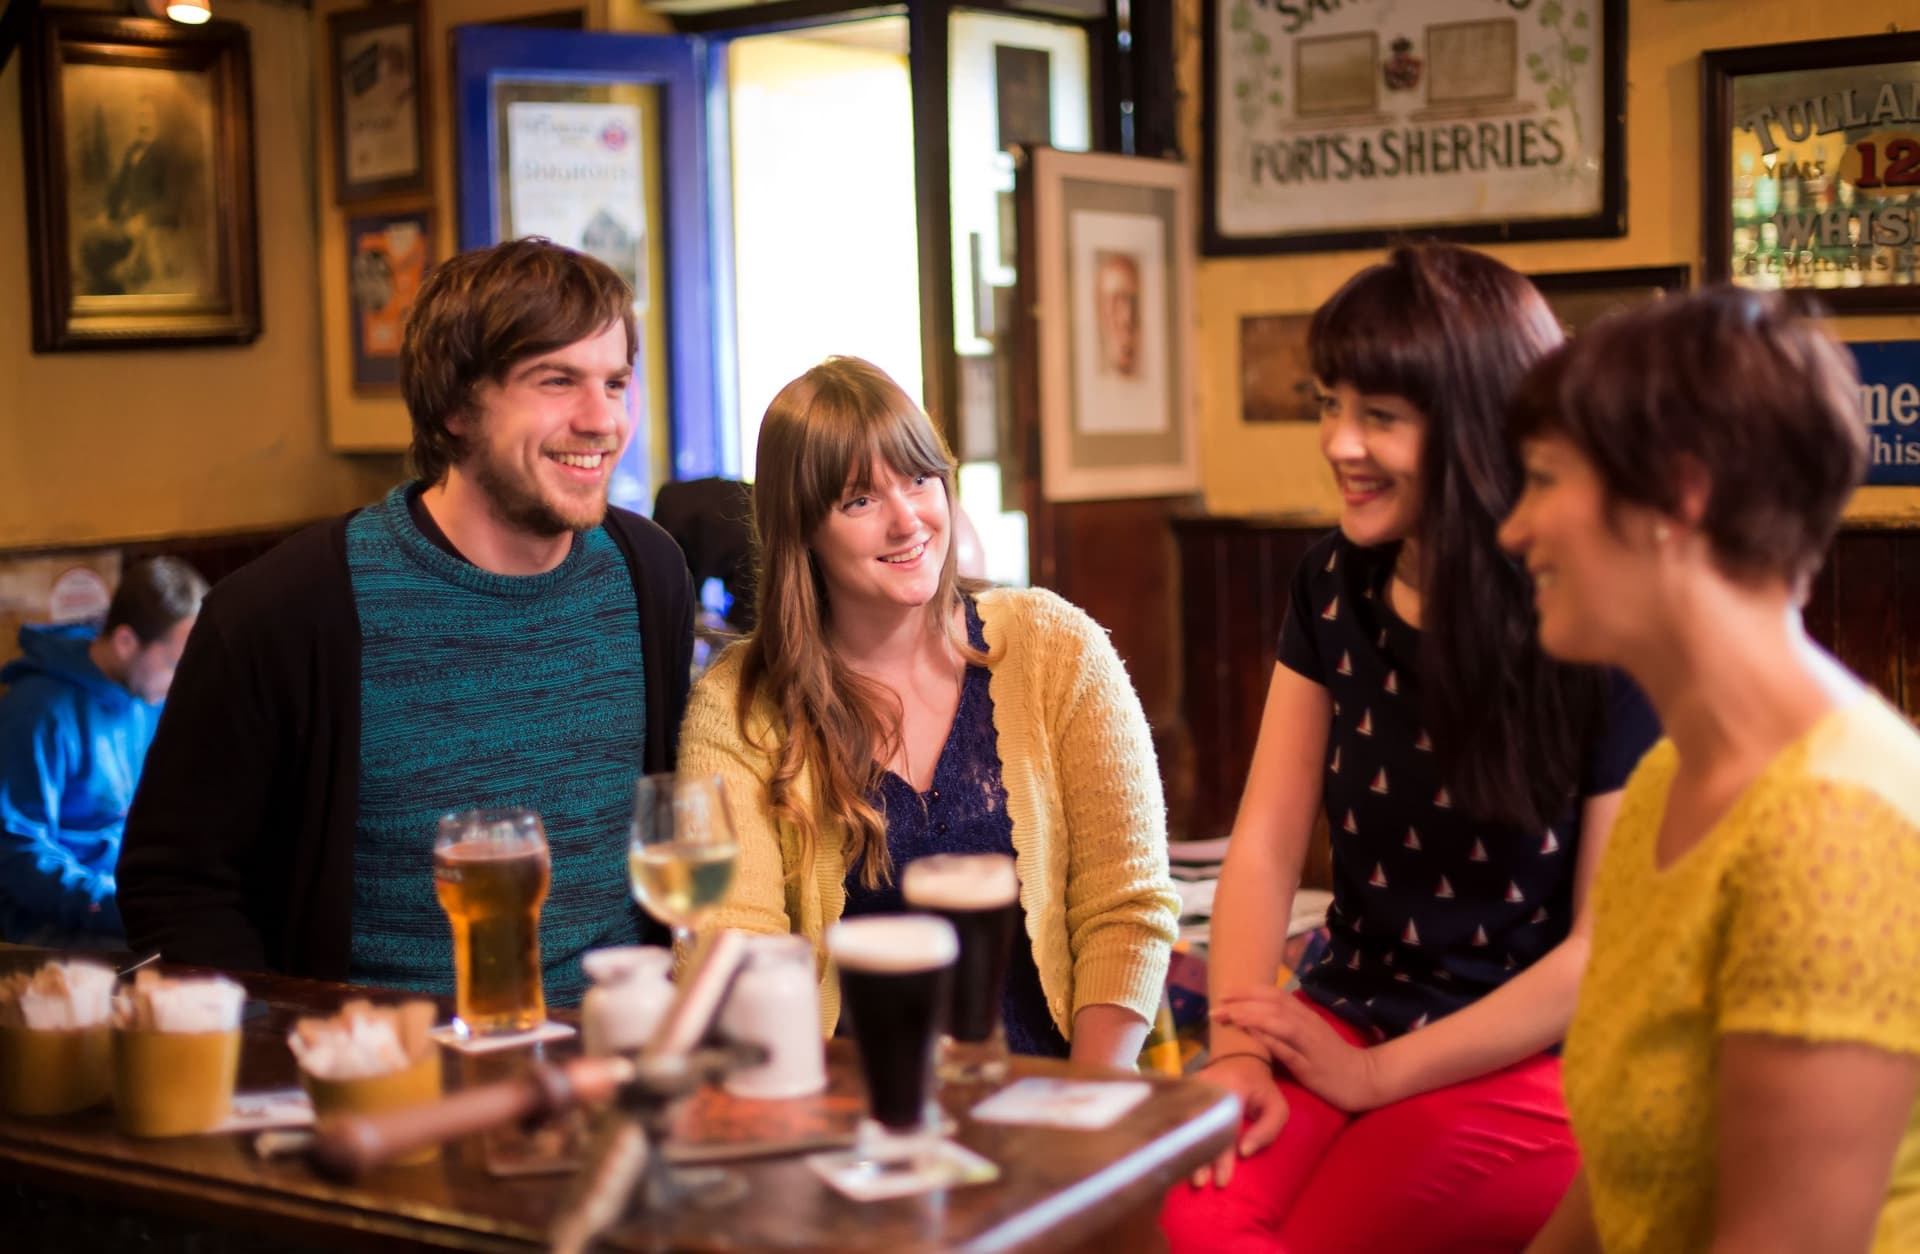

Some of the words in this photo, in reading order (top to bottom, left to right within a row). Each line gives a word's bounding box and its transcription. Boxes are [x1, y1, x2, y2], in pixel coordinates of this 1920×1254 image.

[1743, 83, 1920, 156] TULLA
[1855, 139, 1920, 188] 12
[1770, 206, 1920, 250] WHIS
[1868, 434, 1920, 465] his
